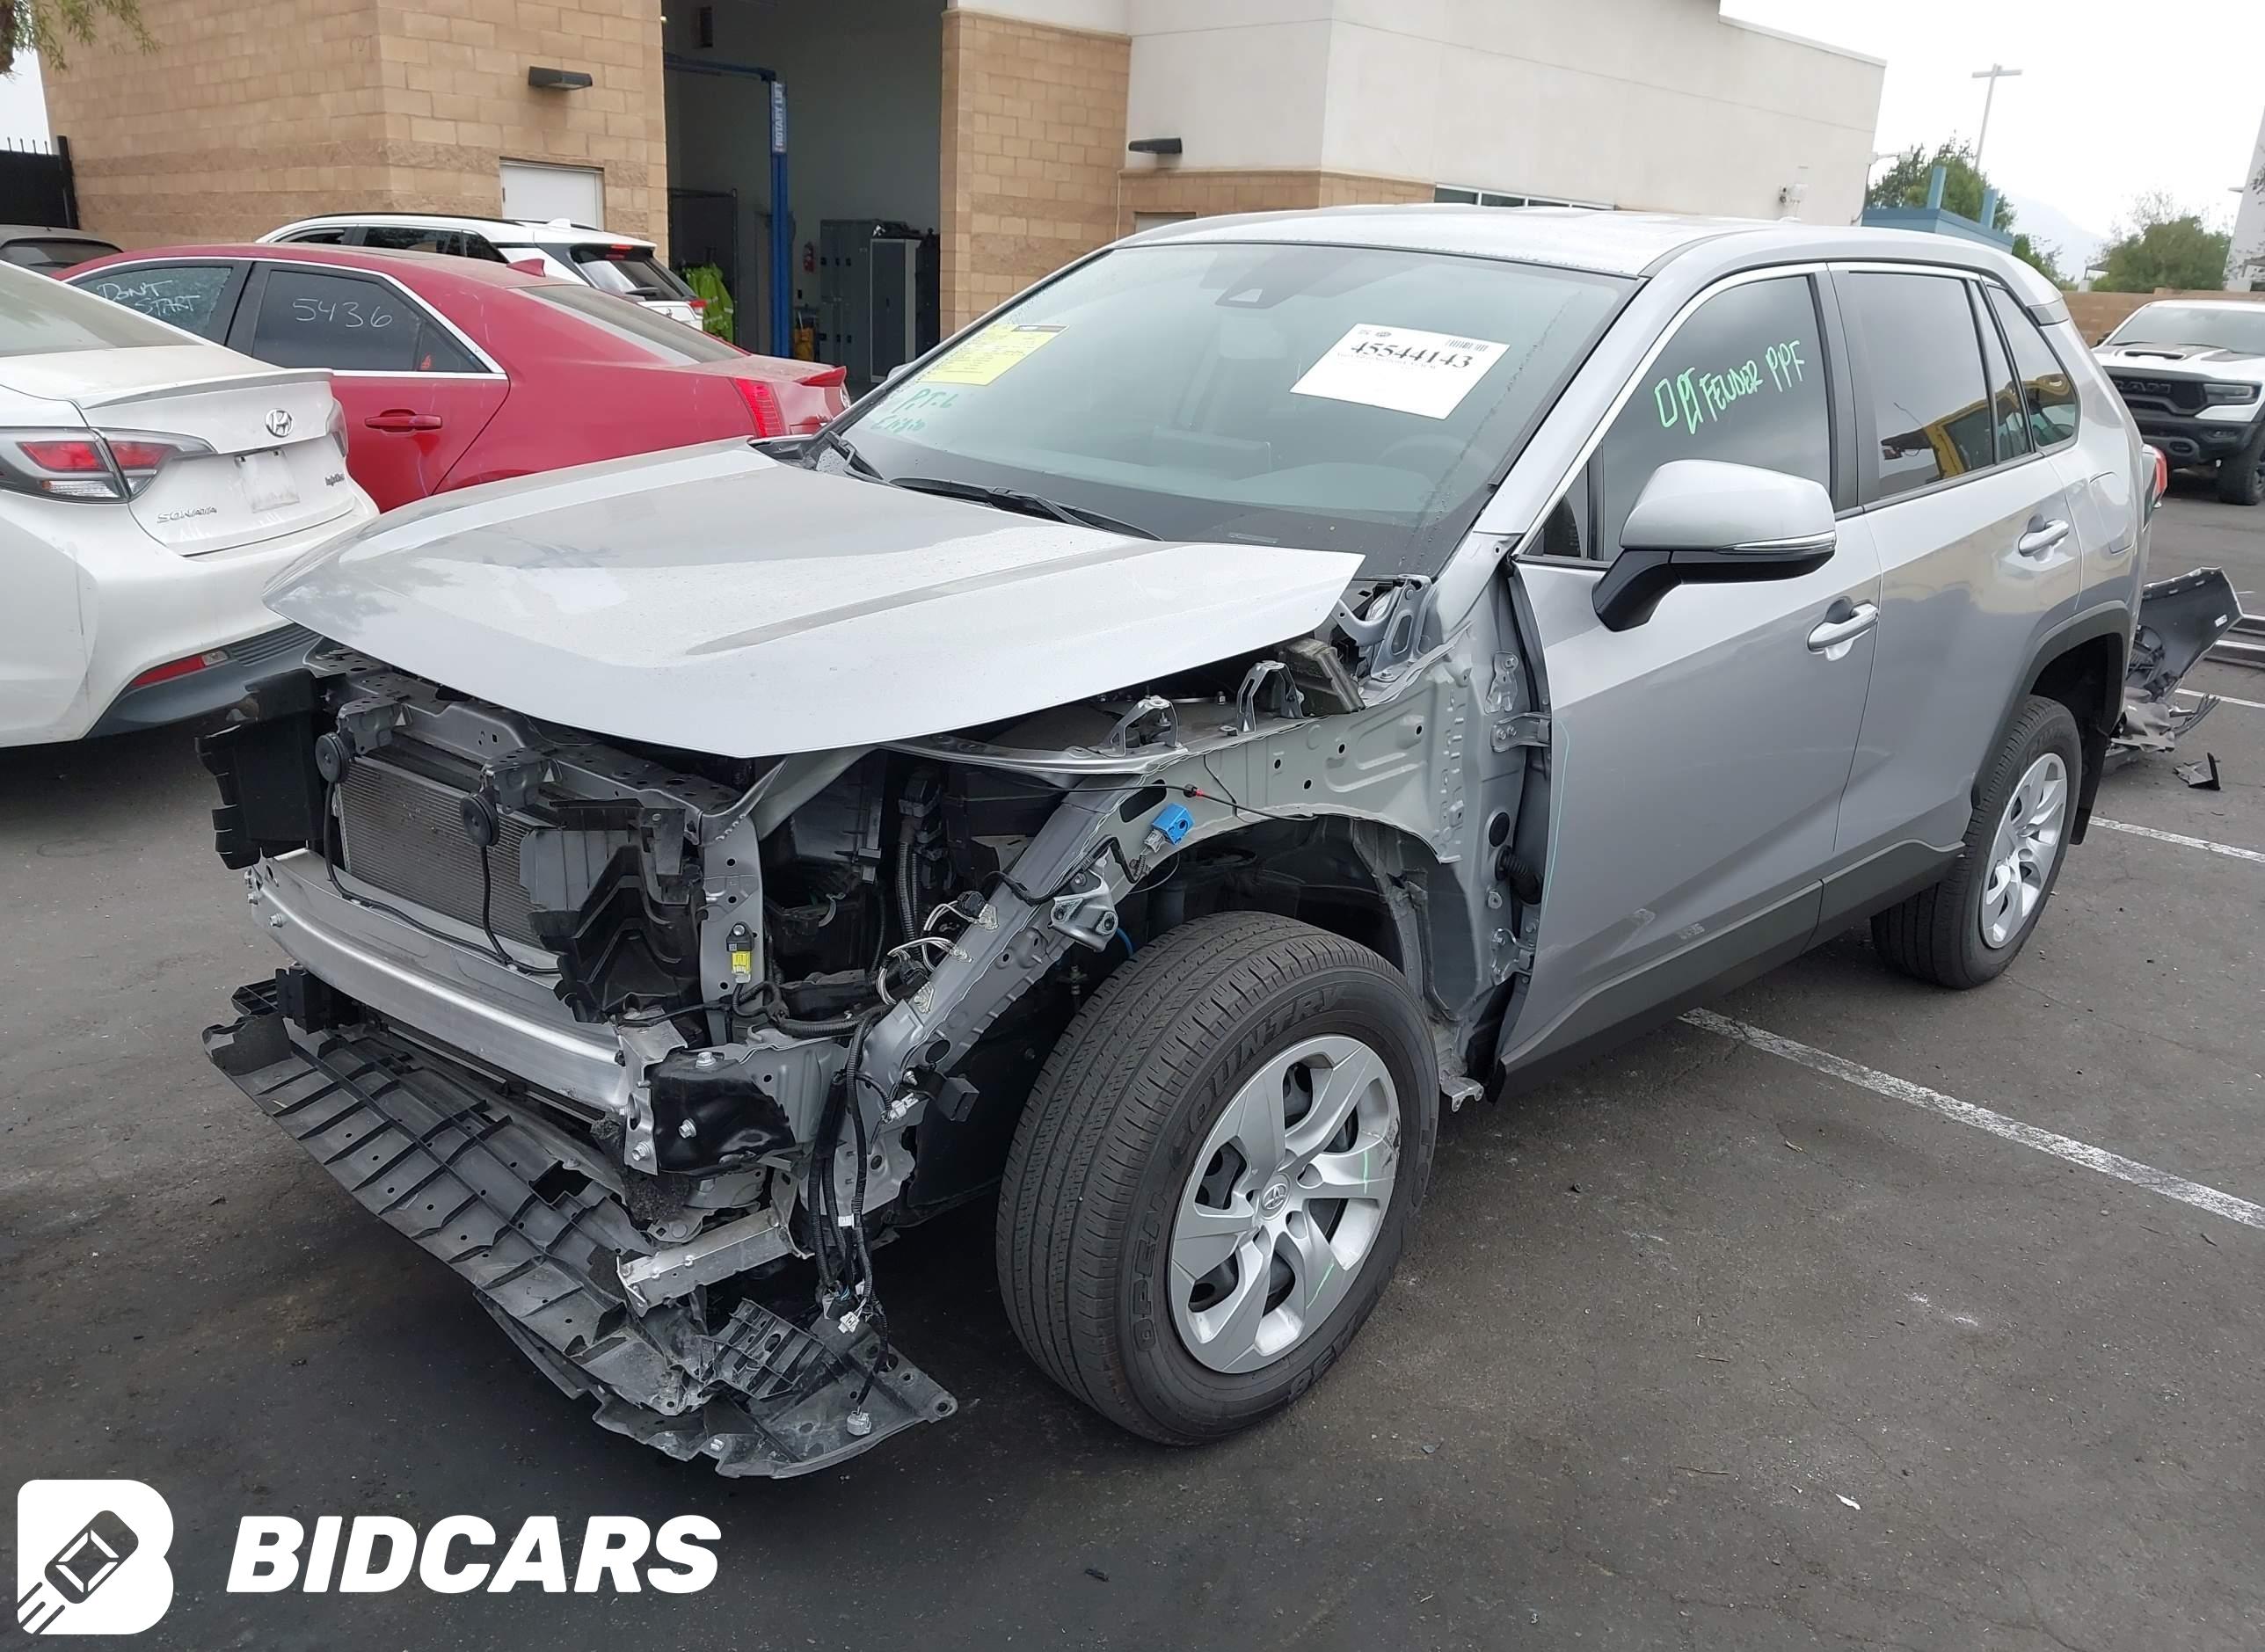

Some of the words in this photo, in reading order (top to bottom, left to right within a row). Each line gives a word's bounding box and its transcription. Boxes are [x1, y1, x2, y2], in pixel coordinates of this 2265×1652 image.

[774, 106, 783, 147] ROTARY
[135, 295, 201, 317] START
[292, 297, 393, 329] 5436
[1351, 341, 1474, 368] 45544143
[1765, 339, 1805, 393] PPF
[157, 506, 218, 524] SONATA
[1132, 1192, 1168, 1352] OPEN
